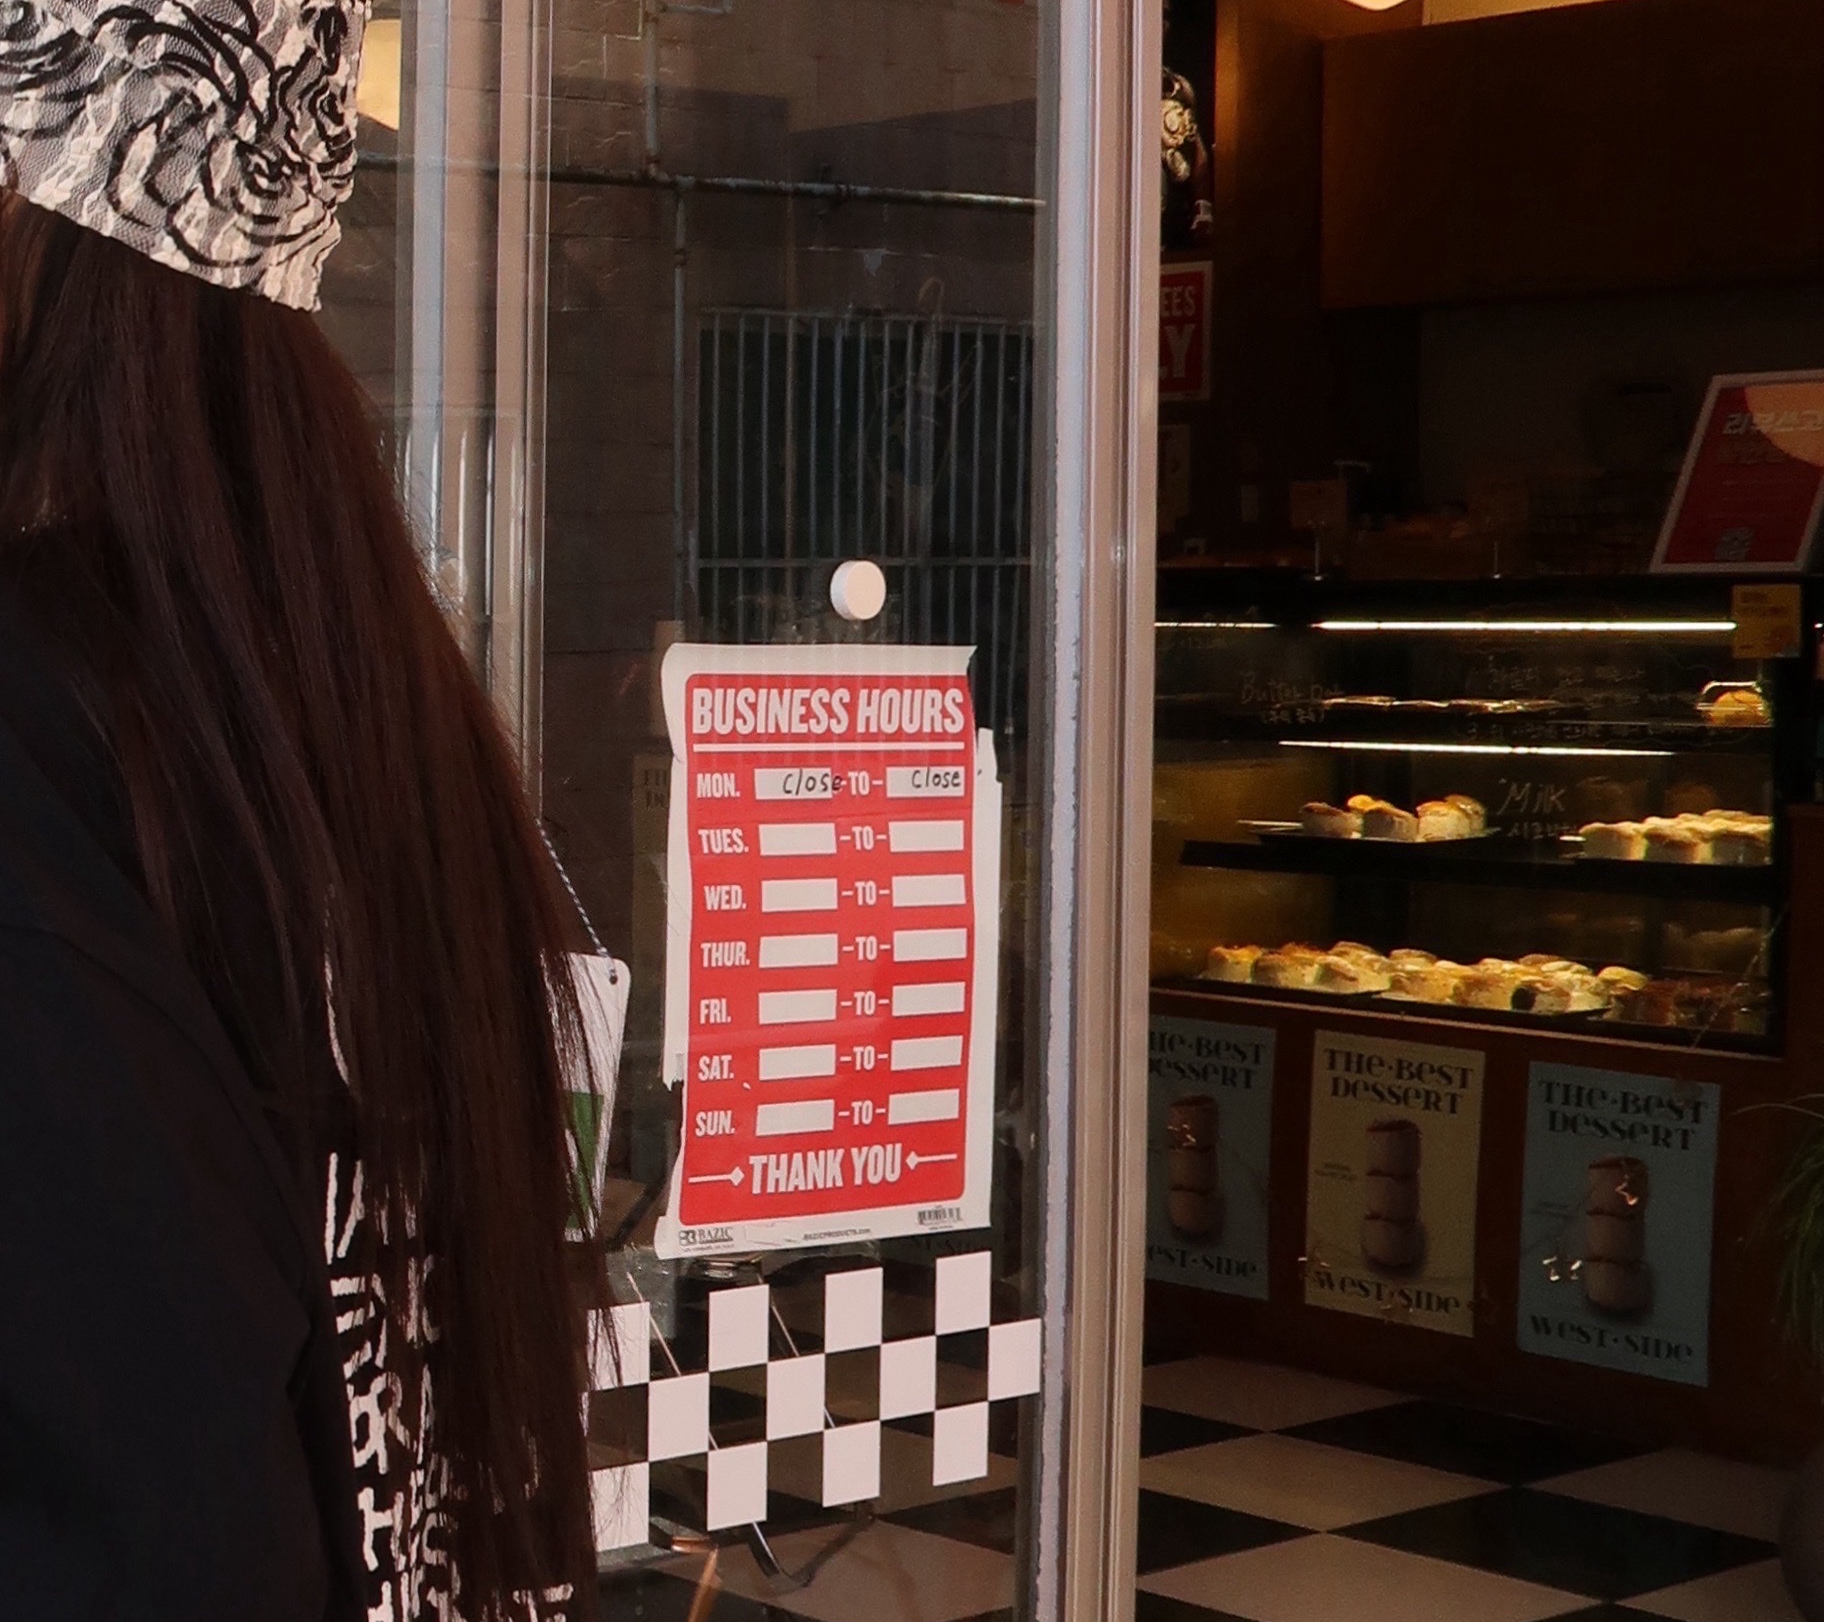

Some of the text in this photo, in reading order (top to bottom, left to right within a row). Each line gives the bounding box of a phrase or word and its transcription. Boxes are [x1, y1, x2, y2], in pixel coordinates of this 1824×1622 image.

[692, 687, 965, 735] BUSINESS HOURS
[696, 773, 740, 798] MON.
[698, 828, 749, 855] TUES.
[704, 884, 746, 911] WED.
[700, 941, 750, 968] THUR.
[699, 997, 731, 1025] FRI.
[697, 1054, 735, 1082] SAT.
[694, 1110, 736, 1137] SUN.
[748, 1142, 903, 1195] THANK YOU
[697, 1226, 734, 1241] BAZIC
